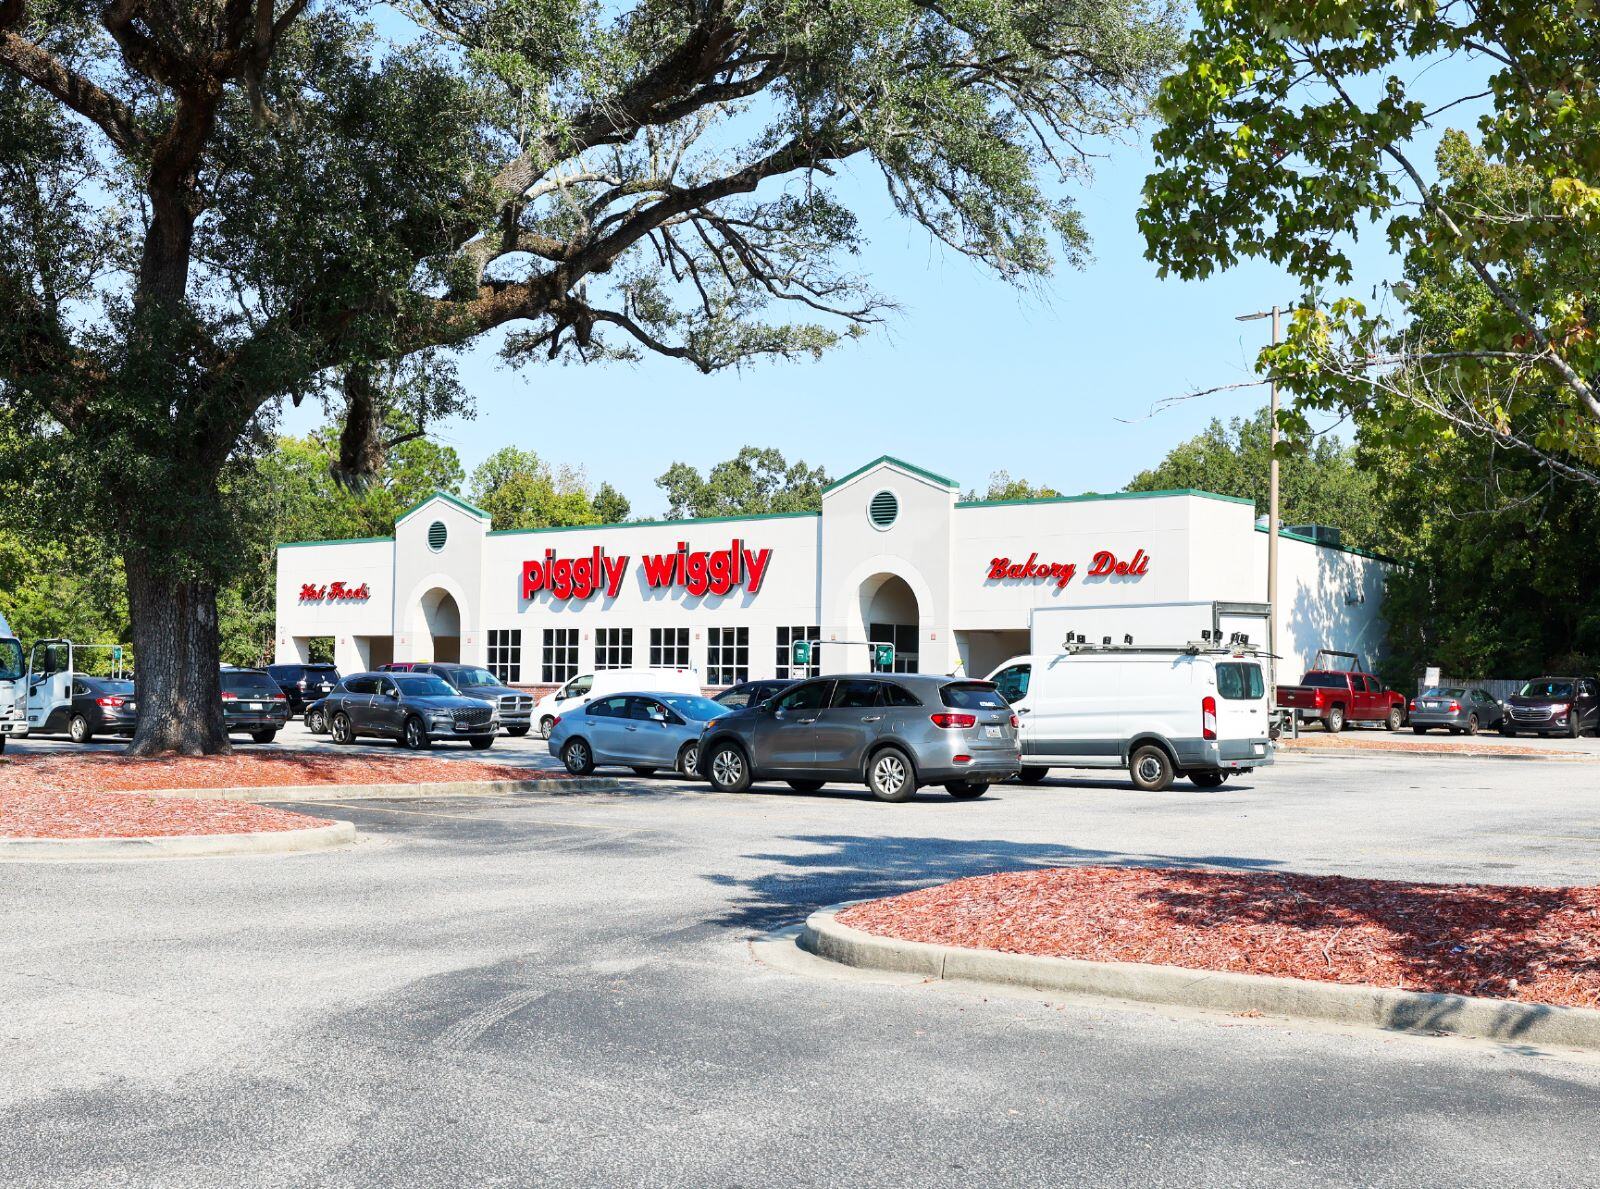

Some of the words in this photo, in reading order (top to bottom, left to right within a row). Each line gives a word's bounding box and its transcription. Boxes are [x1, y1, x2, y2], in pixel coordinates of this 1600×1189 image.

[522, 545, 629, 600] piggly
[641, 538, 772, 597] wiggly
[1087, 549, 1149, 577] Deli
[299, 583, 327, 601] Hot
[327, 581, 371, 601] Foods
